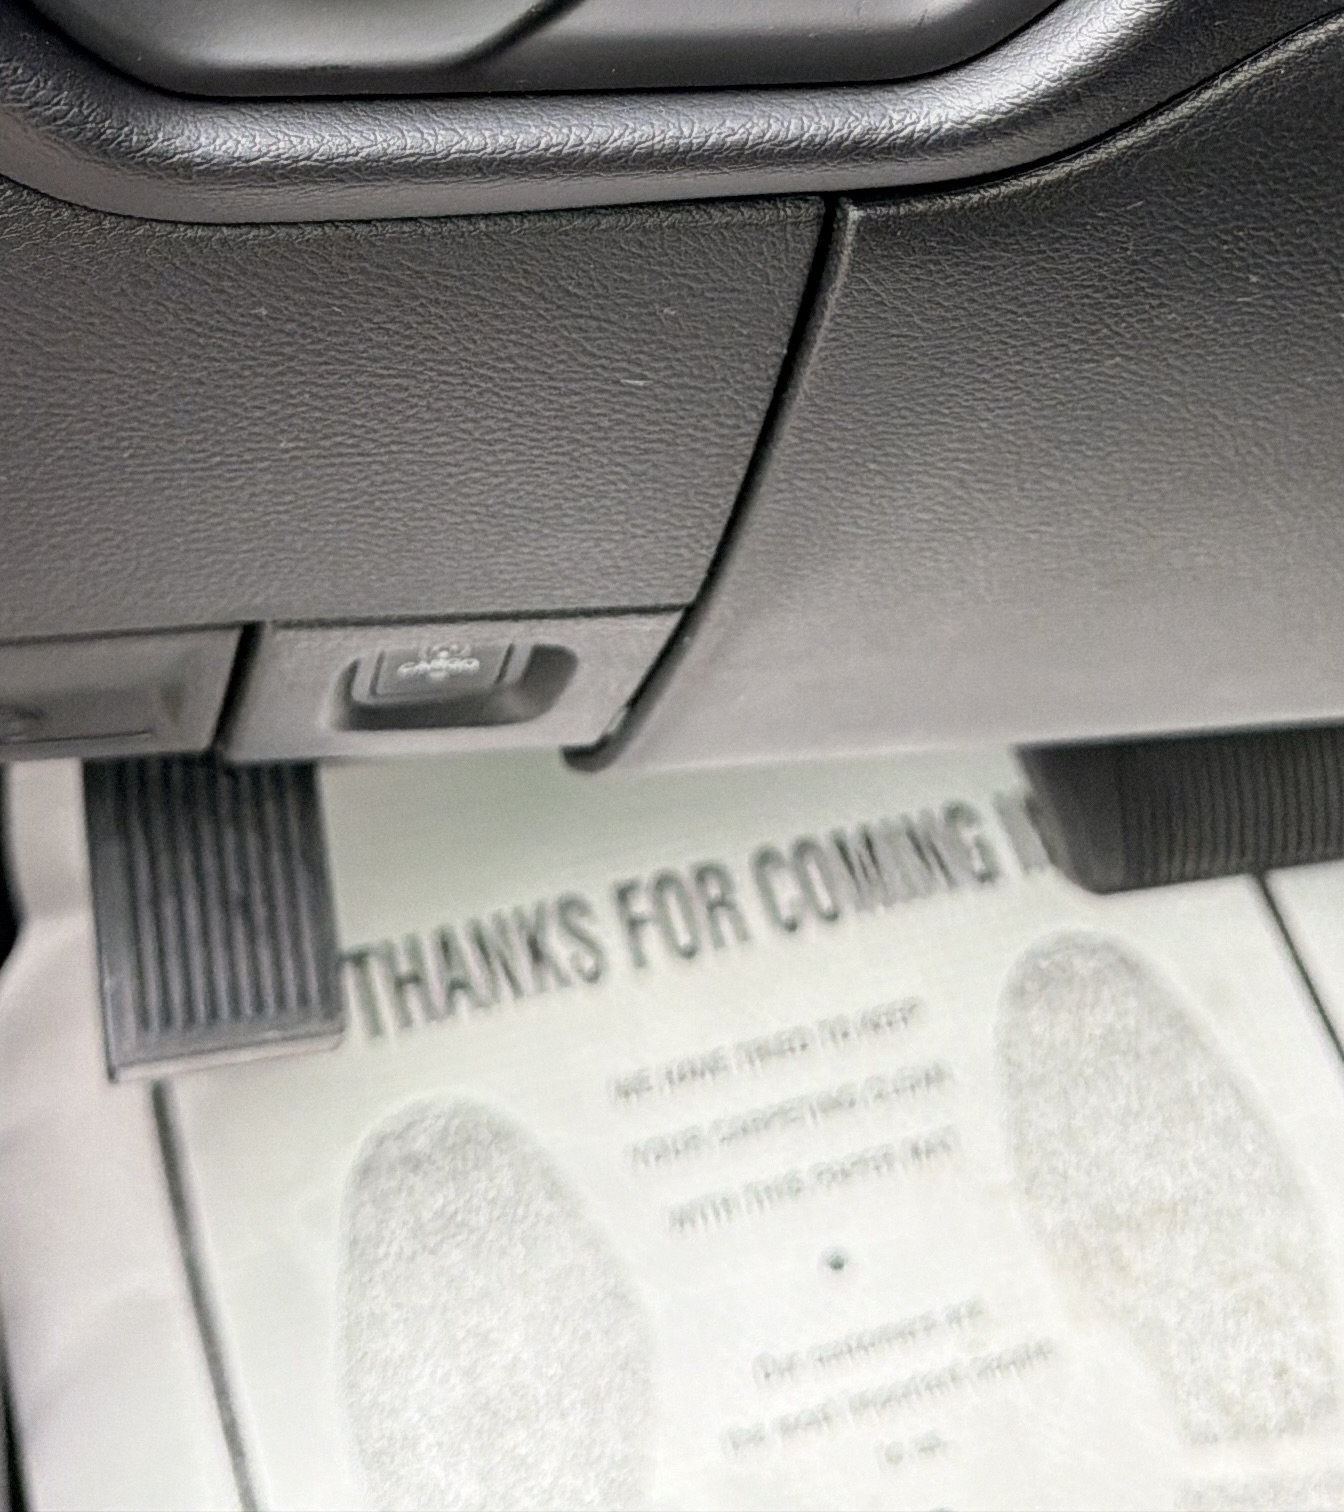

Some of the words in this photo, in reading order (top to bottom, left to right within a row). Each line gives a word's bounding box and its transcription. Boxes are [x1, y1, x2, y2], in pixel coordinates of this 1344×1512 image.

[340, 892, 606, 1036] THANKS
[613, 860, 750, 969] FOR
[749, 799, 999, 933] COMING
